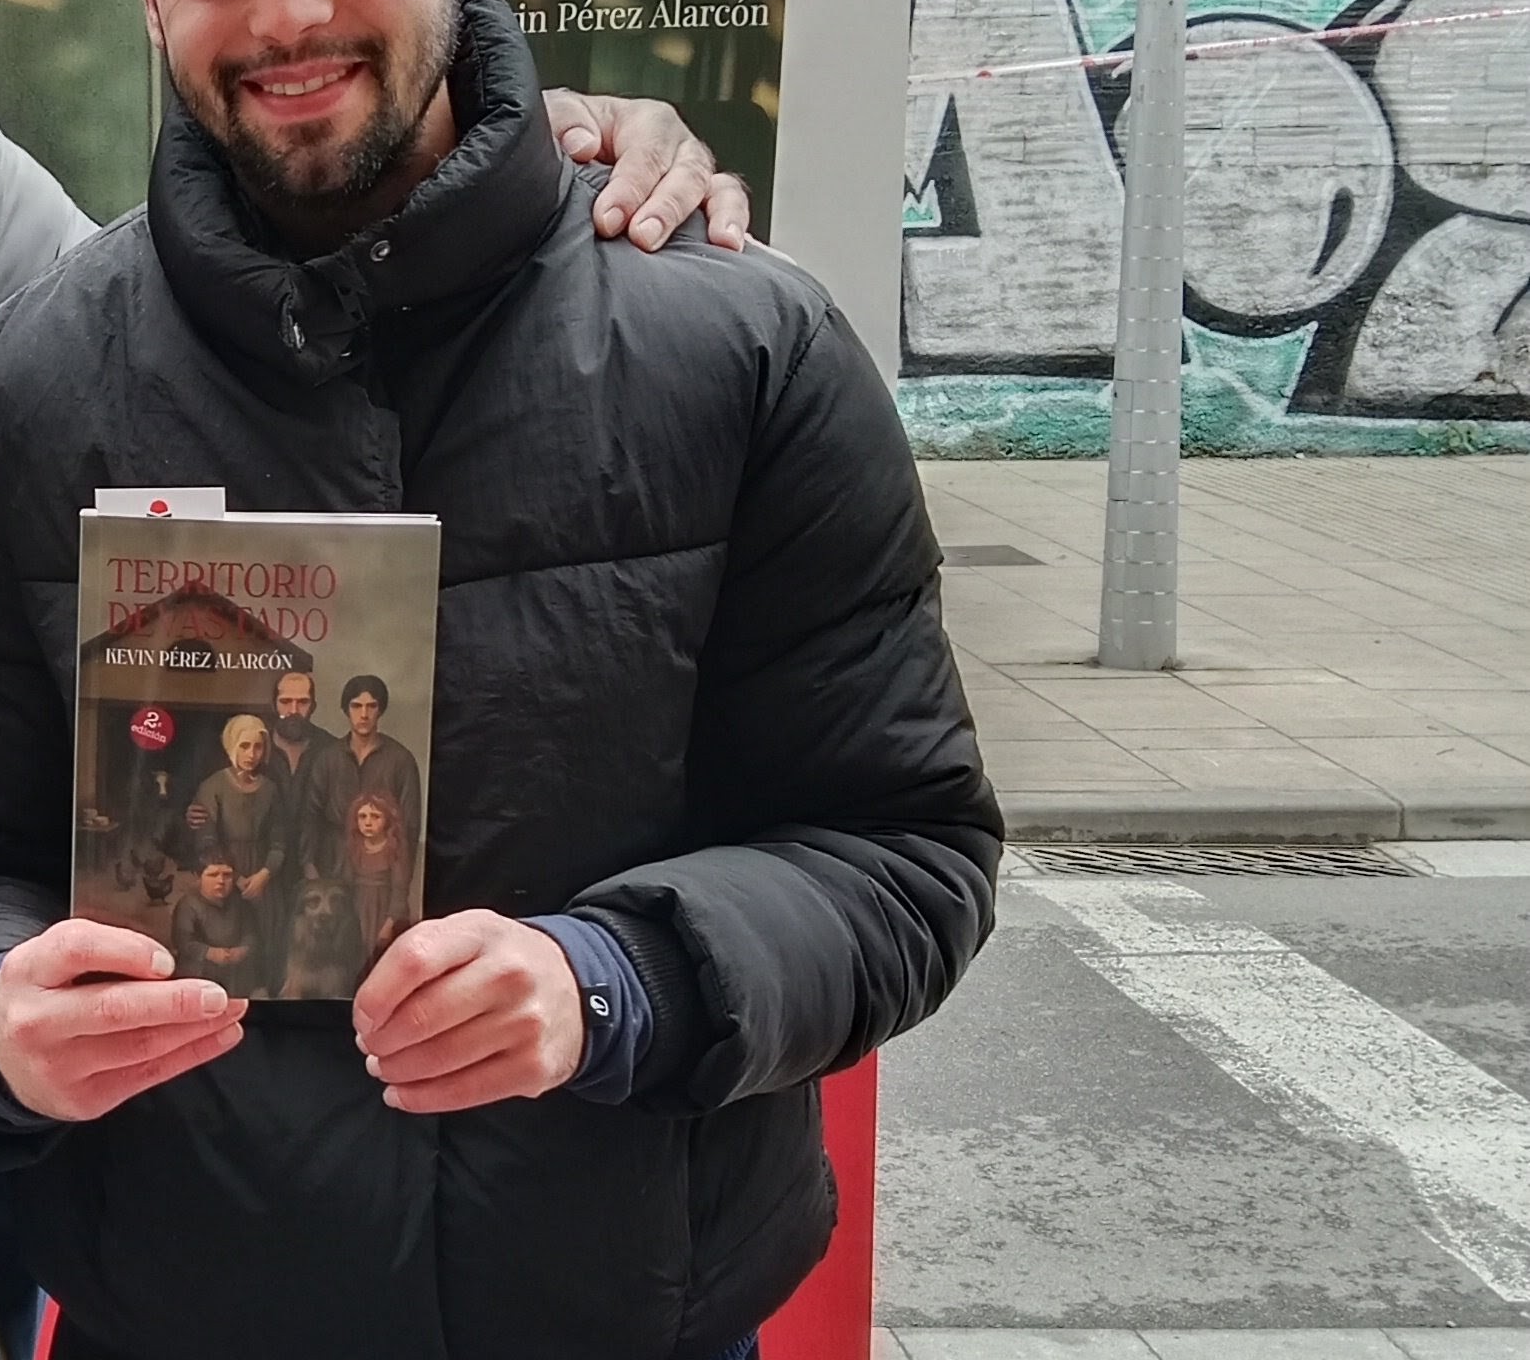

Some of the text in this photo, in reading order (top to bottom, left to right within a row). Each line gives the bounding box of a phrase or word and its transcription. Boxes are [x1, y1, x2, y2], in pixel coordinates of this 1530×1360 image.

[107, 558, 337, 600] TERRITORIO
[105, 646, 294, 670] KEVIN PÉREZ ALARCÓN
